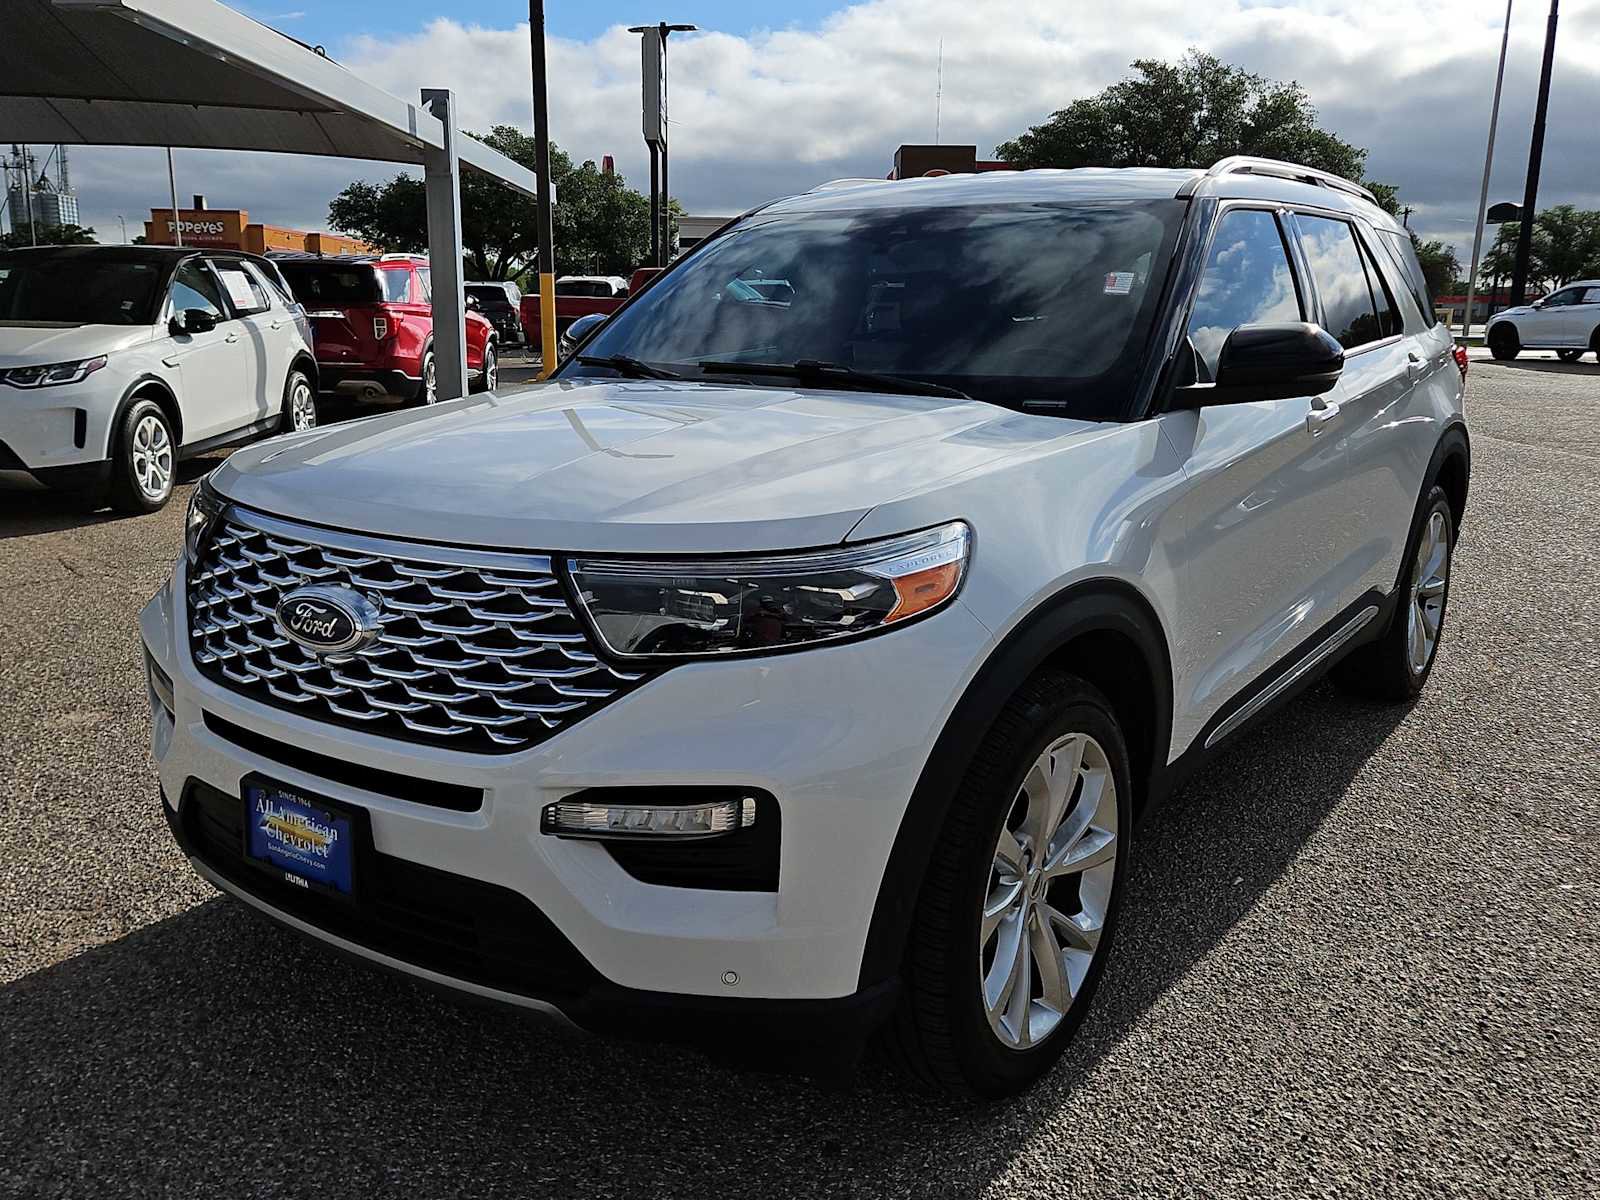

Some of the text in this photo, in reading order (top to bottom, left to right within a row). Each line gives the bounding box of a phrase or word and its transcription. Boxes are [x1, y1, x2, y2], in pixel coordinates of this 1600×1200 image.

[291, 602, 338, 638] Ford
[278, 789, 297, 804] SINCE
[256, 798, 338, 841] All American
[265, 822, 329, 858] Chevrolet
